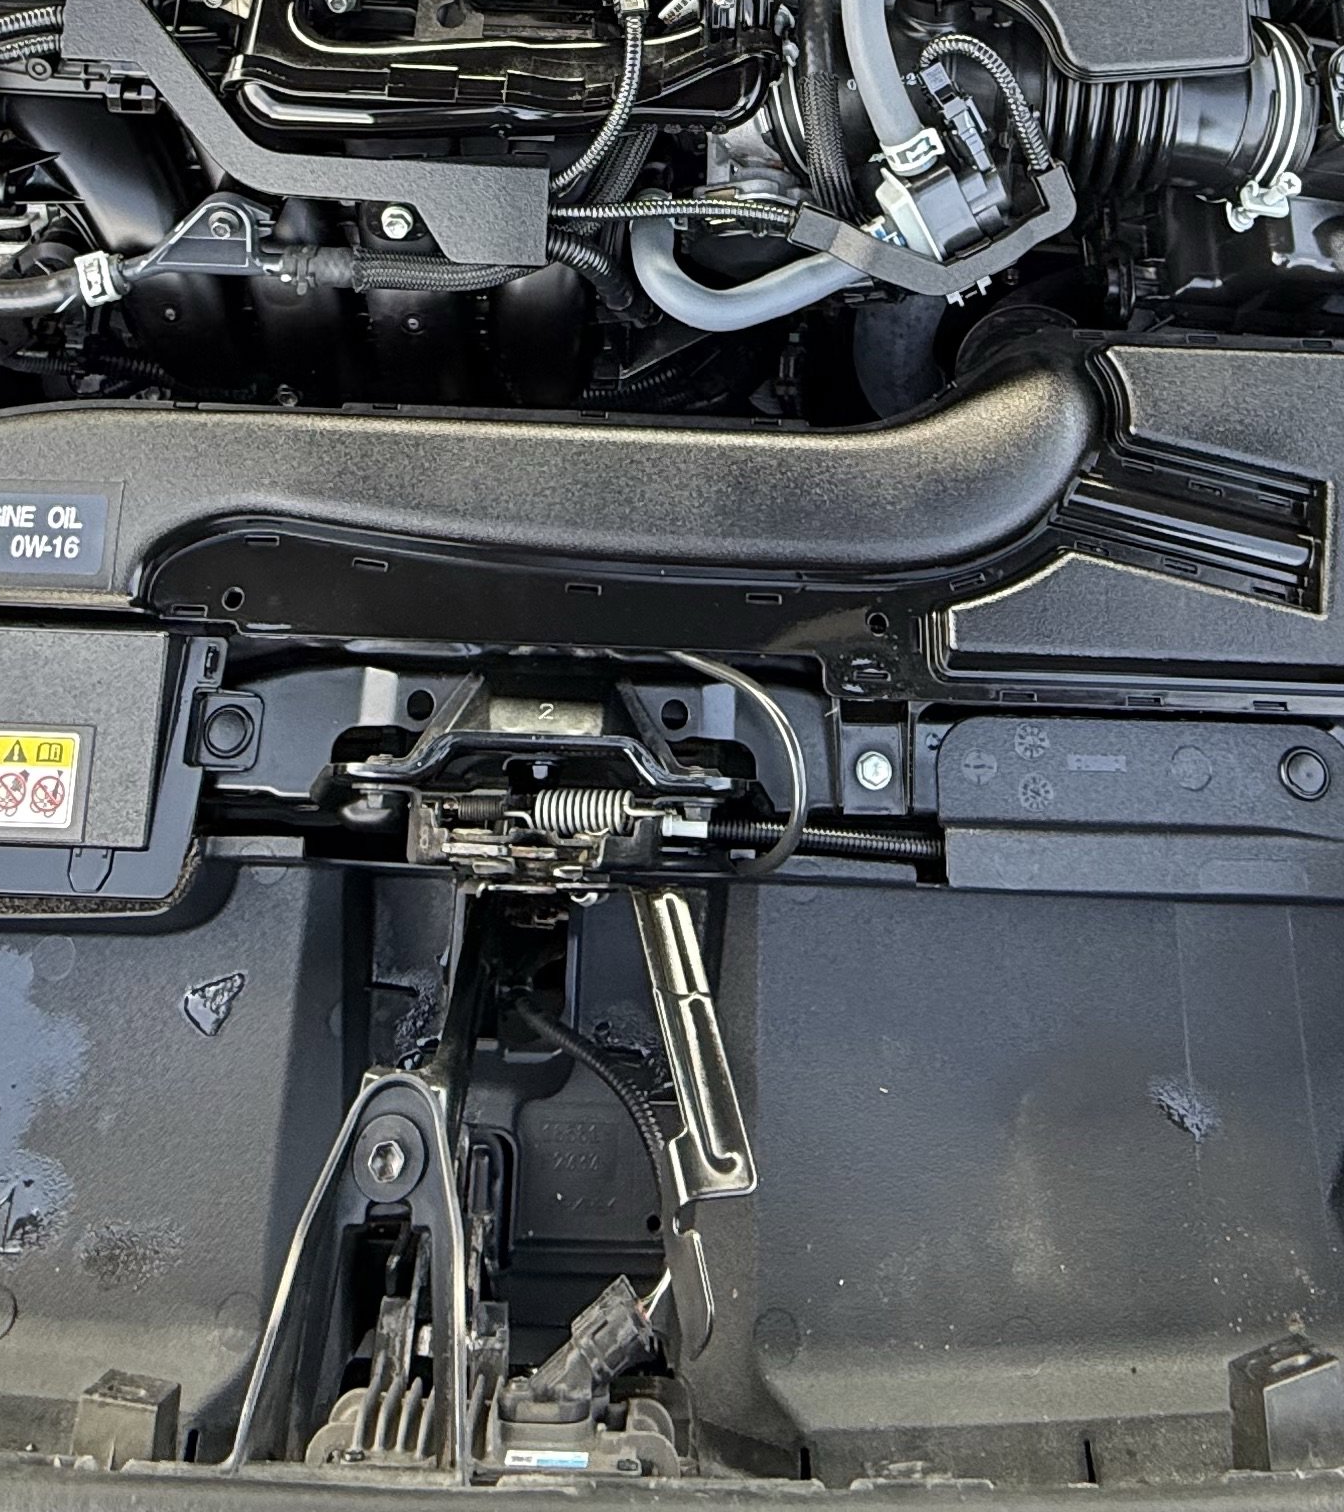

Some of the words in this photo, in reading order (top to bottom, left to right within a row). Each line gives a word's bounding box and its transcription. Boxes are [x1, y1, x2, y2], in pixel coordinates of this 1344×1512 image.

[47, 506, 83, 529] OIL
[10, 534, 80, 559] 0W-16
[538, 702, 554, 720] 2
